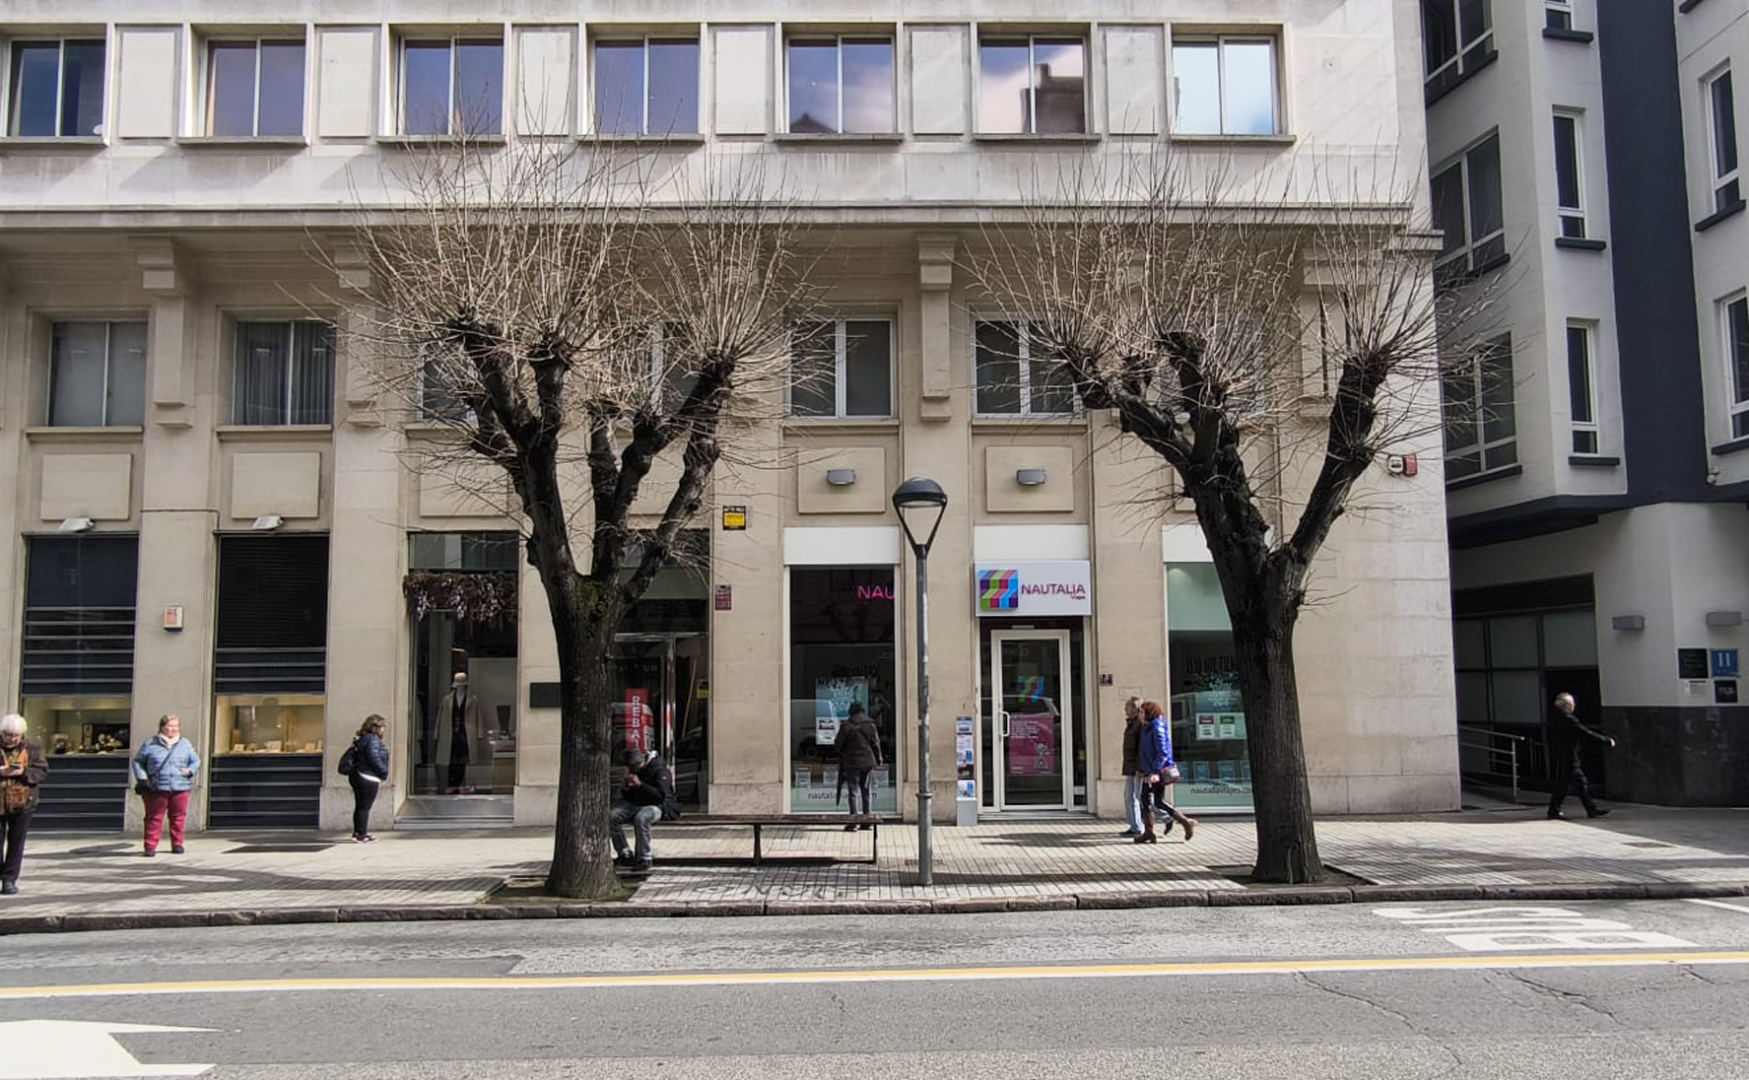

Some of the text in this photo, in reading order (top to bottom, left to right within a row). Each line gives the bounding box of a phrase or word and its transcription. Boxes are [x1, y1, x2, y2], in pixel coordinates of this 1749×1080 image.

[857, 585, 896, 600] NAU
[1021, 583, 1086, 595] NAUTALIA
[1372, 906, 1700, 952] BUS
